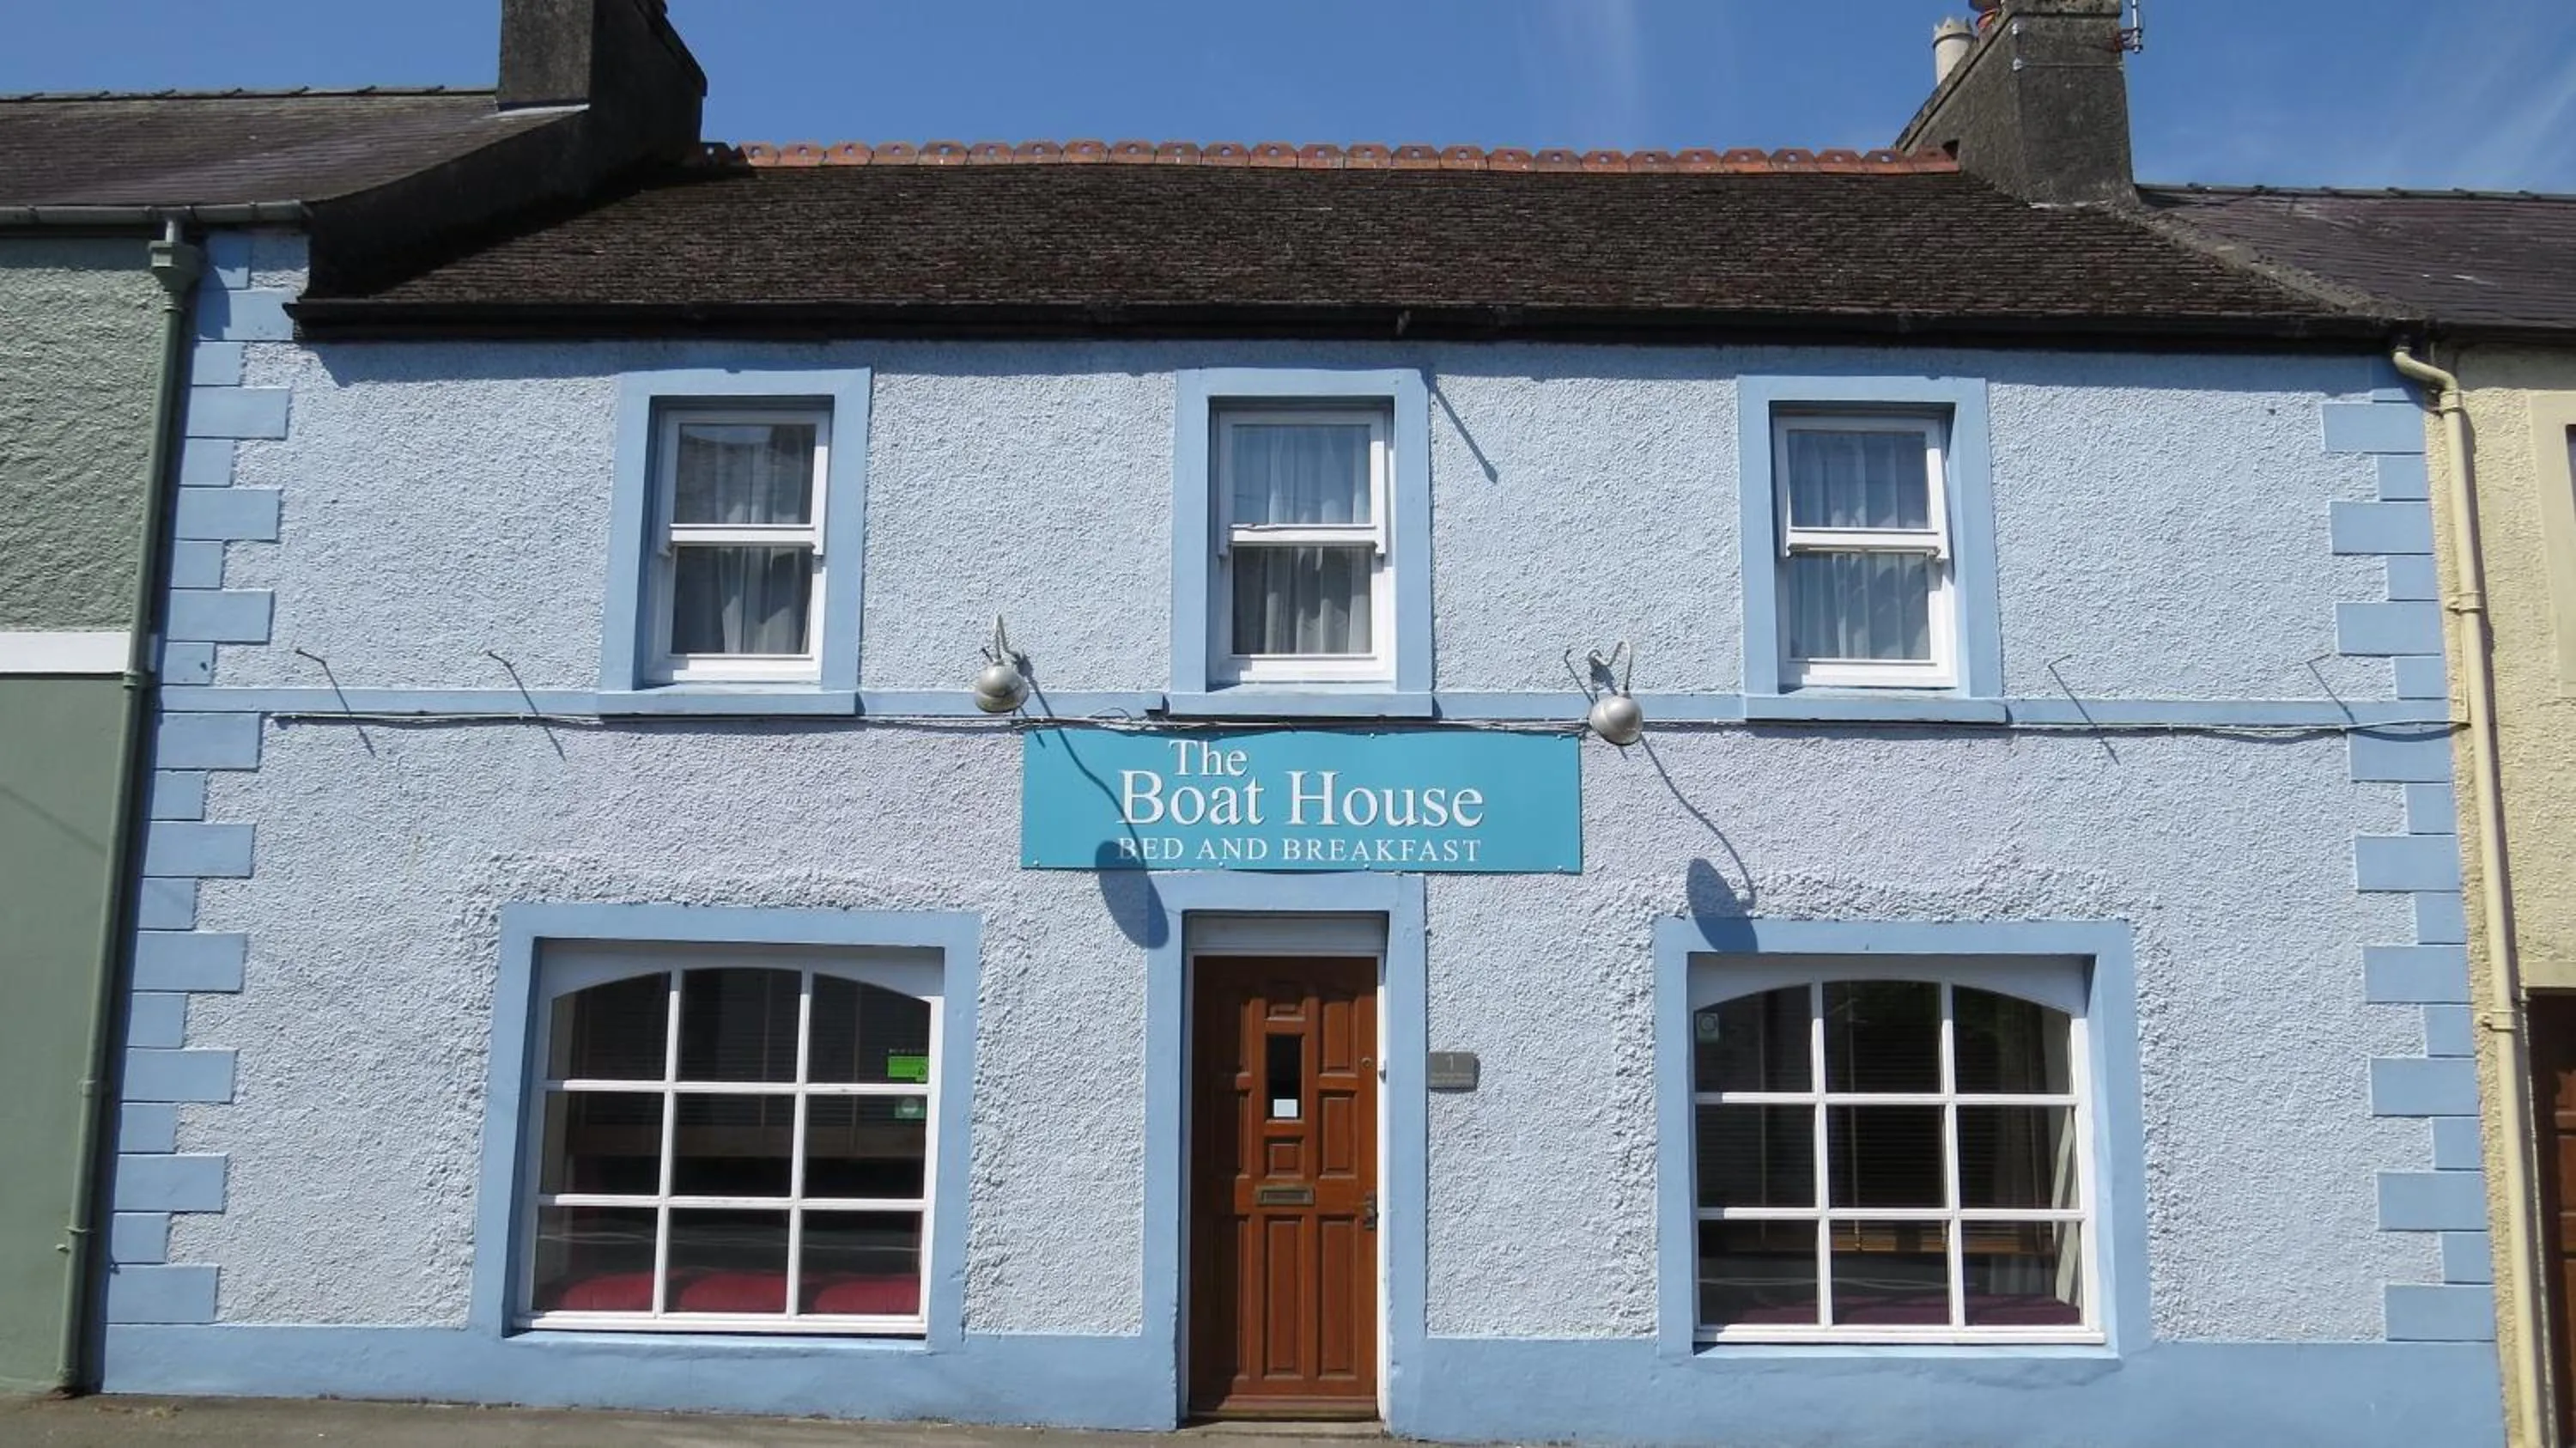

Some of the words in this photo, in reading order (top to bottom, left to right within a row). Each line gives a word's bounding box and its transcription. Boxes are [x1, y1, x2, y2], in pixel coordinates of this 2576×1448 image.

[1170, 740, 1248, 776] The
[1116, 770, 1264, 825] Boat
[1286, 771, 1484, 827] House
[1119, 837, 1184, 861] BED
[1196, 838, 1268, 861] AND
[1283, 839, 1481, 862] BREAKFAST
